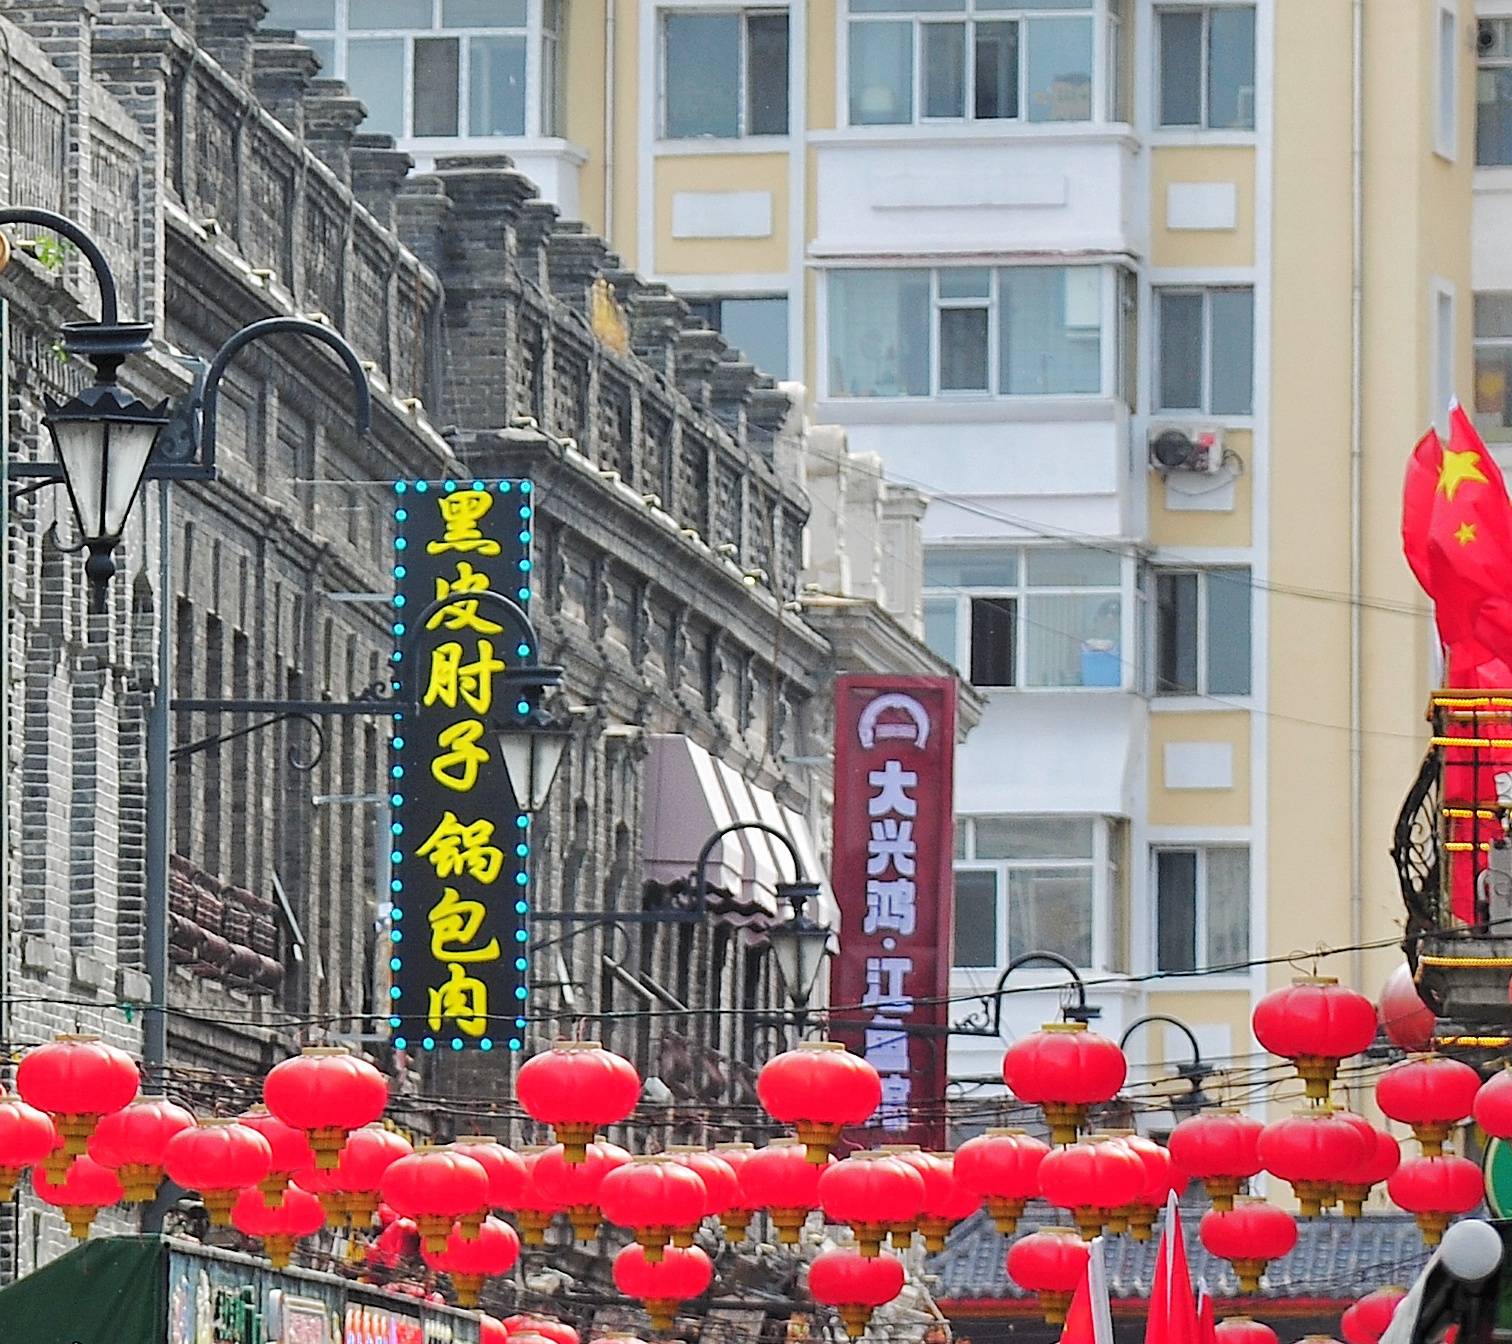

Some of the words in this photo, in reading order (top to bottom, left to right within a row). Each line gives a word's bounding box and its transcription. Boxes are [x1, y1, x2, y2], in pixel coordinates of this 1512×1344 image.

[422, 489, 506, 793] 黑皮肘子
[415, 811, 506, 1036] 锅包肉
